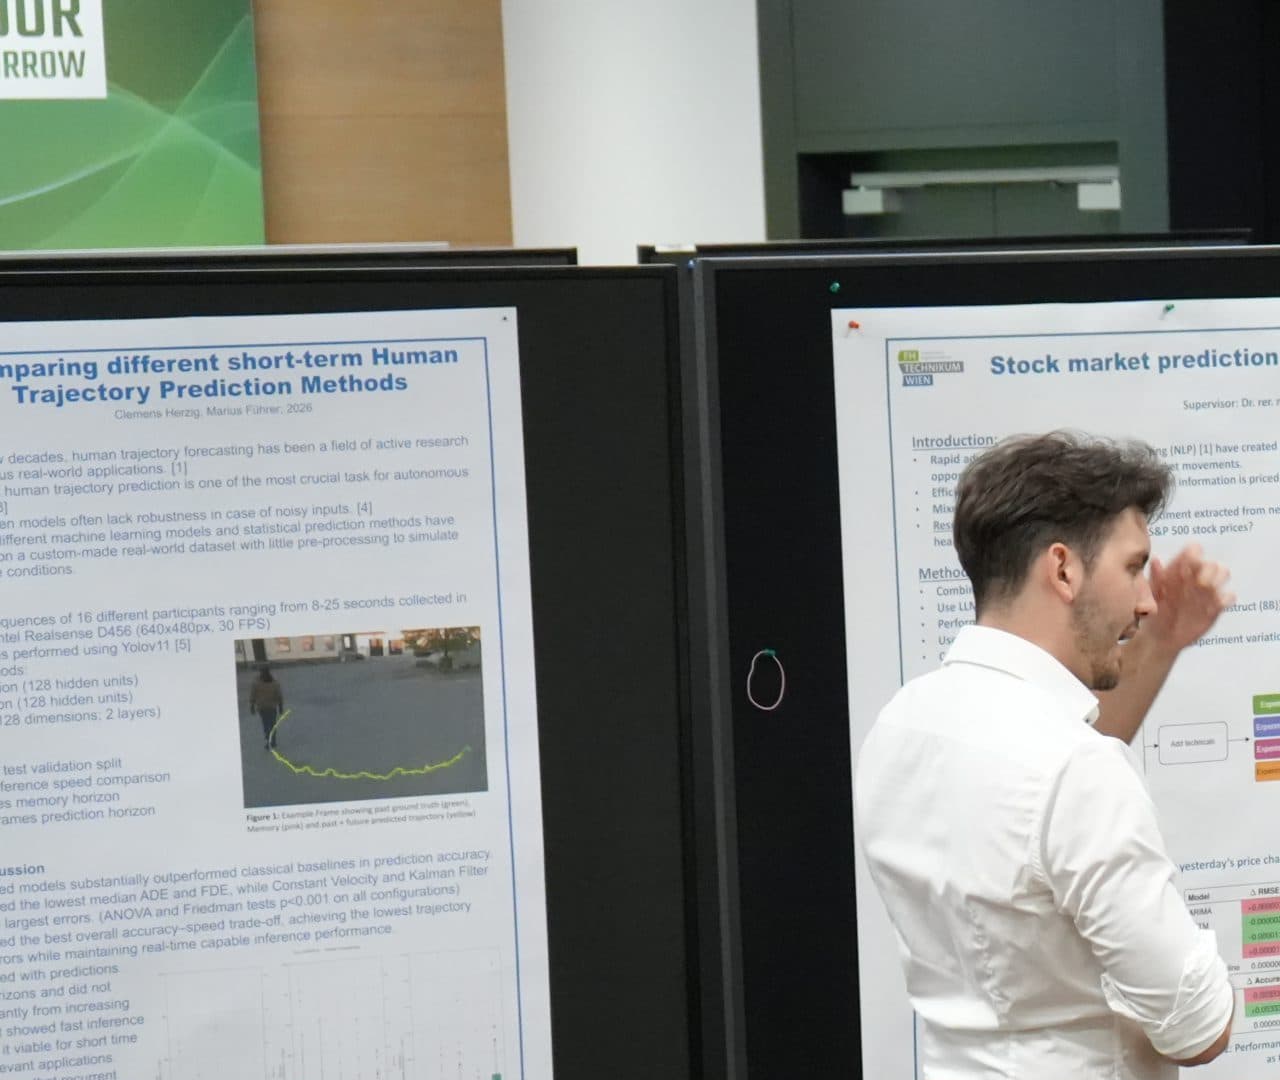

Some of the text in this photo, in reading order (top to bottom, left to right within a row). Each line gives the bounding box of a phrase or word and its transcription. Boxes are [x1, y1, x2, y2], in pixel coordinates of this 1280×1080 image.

[4, 50, 85, 78] RROW
[107, 354, 219, 374] different
[227, 351, 363, 370] short-term
[371, 347, 458, 365] Human
[990, 354, 1060, 374] Stock
[1068, 352, 1150, 371] market
[1157, 349, 1278, 372] prediction
[11, 373, 408, 406] Trajectory Prediction Methods
[905, 375, 930, 384] WIEN
[71, 450, 117, 461] human
[120, 448, 180, 461] trajectory
[183, 445, 253, 457] forecasting
[257, 443, 281, 454] has
[283, 441, 315, 453] been
[319, 442, 328, 452] a
[330, 439, 357, 451] field
[360, 438, 372, 450] of
[375, 439, 411, 449] active
[415, 435, 469, 447] research
[930, 453, 960, 465] Rapid
[1169, 443, 1196, 456] (NLP)
[1199, 442, 1213, 456] [1]
[1215, 443, 1239, 453] have
[1241, 440, 1277, 452] created
[18, 516, 66, 528] models
[69, 514, 103, 526] often
[106, 512, 132, 524] lack
[136, 511, 207, 523] robustness
[210, 510, 222, 520] in
[225, 509, 256, 519] case
[259, 505, 272, 518] of
[275, 506, 308, 518] noisy
[356, 501, 372, 516] [4]
[1148, 521, 1253, 537] S&P 500 stock prices?
[59, 592, 467, 624] of 16 different participants ranging from 8-25 seconds collected in
[97, 624, 132, 638] D456
[218, 619, 234, 631] 30
[238, 617, 270, 630] FPS)
[1187, 893, 1210, 901] Model
